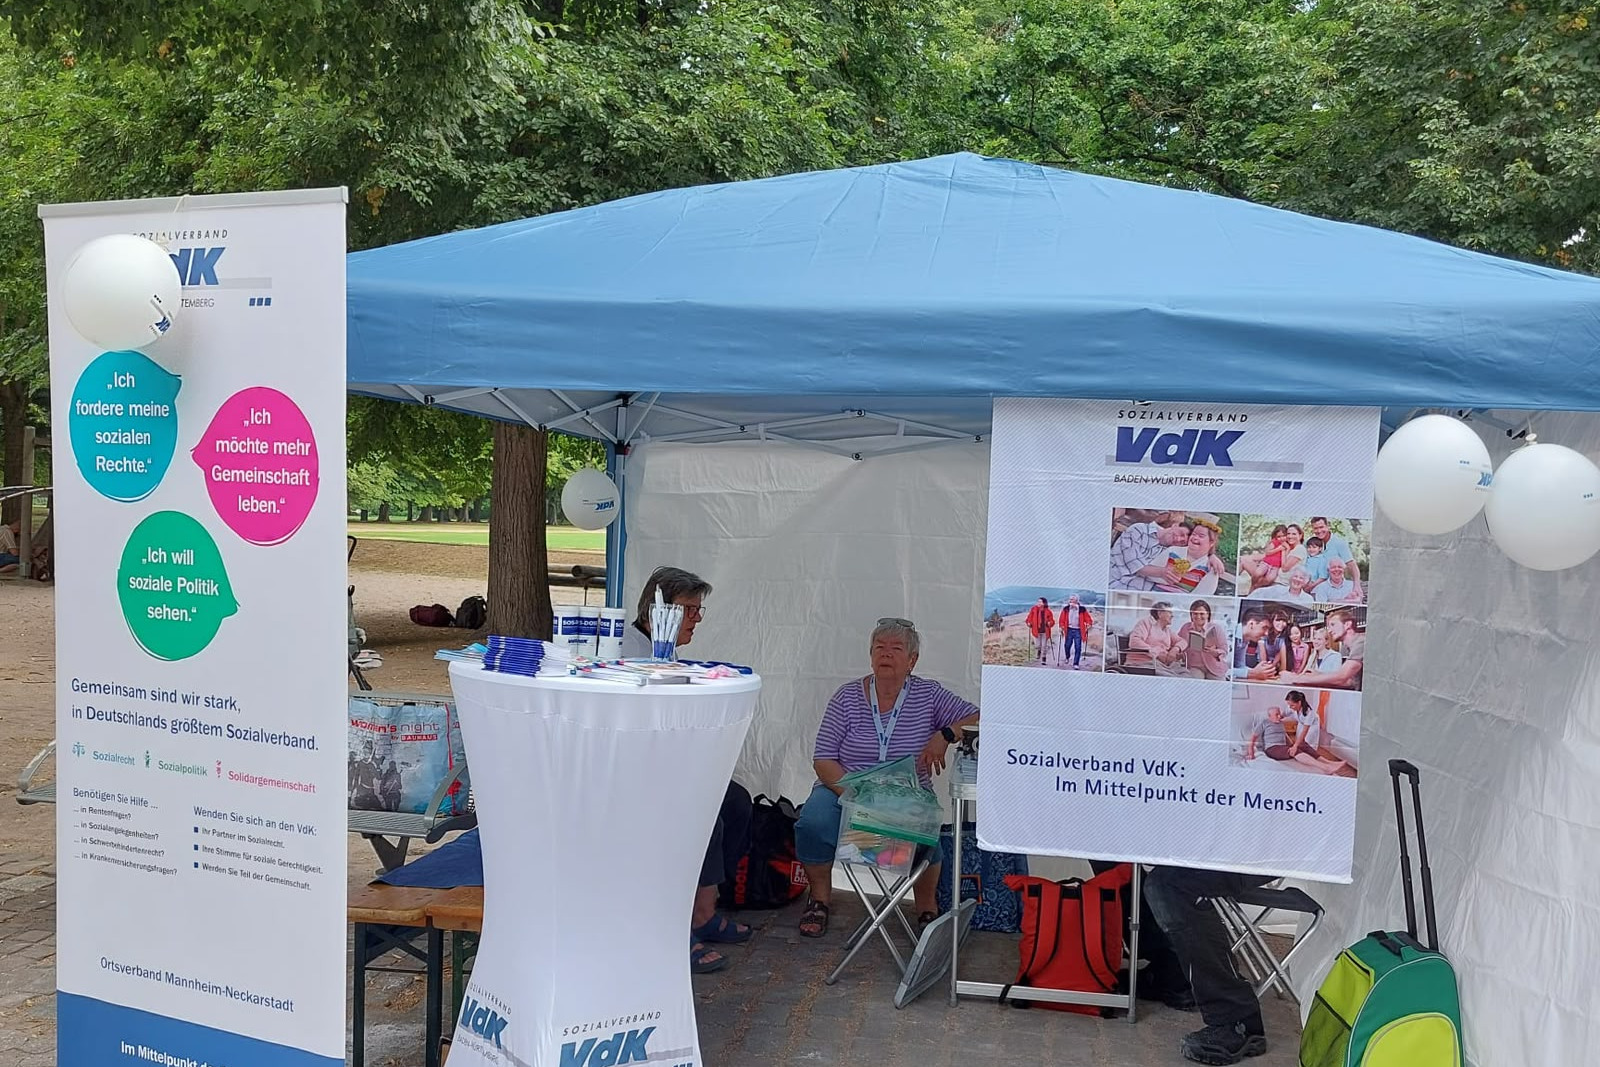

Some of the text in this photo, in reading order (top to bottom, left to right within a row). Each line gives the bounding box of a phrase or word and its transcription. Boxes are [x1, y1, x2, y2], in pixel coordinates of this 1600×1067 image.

[107, 371, 135, 390] „Ich
[76, 400, 170, 417] fordere meine
[243, 407, 271, 427] „Ich
[1117, 409, 1248, 423] SOZIALVERBAND
[95, 428, 151, 445] sozialen
[215, 437, 311, 456] möchte mehr
[1115, 427, 1247, 467] VdK
[211, 464, 310, 486] Gemeinschaft
[1113, 474, 1224, 488] BADEN-WÜRTTEMBERG
[141, 547, 194, 566] „Ich will
[129, 575, 219, 596] soziale Politik
[71, 678, 241, 714] Gemeinsam sind wir stark,
[72, 705, 319, 751] in Deutschlands größtem Sozialverband.
[400, 722, 440, 733] night
[93, 751, 316, 793] Sozialrecht Sozialpolitik Solidargemeinschaft
[1007, 749, 1186, 778] Sozialverband VdK:
[73, 787, 116, 802] Benötigen
[117, 793, 129, 804] Sie
[130, 796, 149, 808] Hilfe
[1056, 776, 1323, 815] Im Mittelpunkt der Mensch.
[88, 806, 132, 820] Rentenfragen?
[193, 805, 317, 837] Wenden Sie sich an den VdK:
[202, 827, 211, 835] Ihr
[211, 828, 236, 840] Partner
[237, 832, 246, 841] im
[202, 844, 214, 854] Ihre
[215, 846, 241, 859] Stimme
[242, 852, 252, 861] für
[253, 854, 276, 865] soziale
[202, 862, 312, 891] Werden Sie Teil der Gemeinschaft.
[100, 956, 295, 1013] Ortsverband Mannheim-Neckarstadt
[461, 995, 508, 1049] VdK
[563, 1011, 661, 1037] SOZIALVERBAND
[121, 1040, 135, 1056] Im
[559, 1026, 657, 1067] VdK
